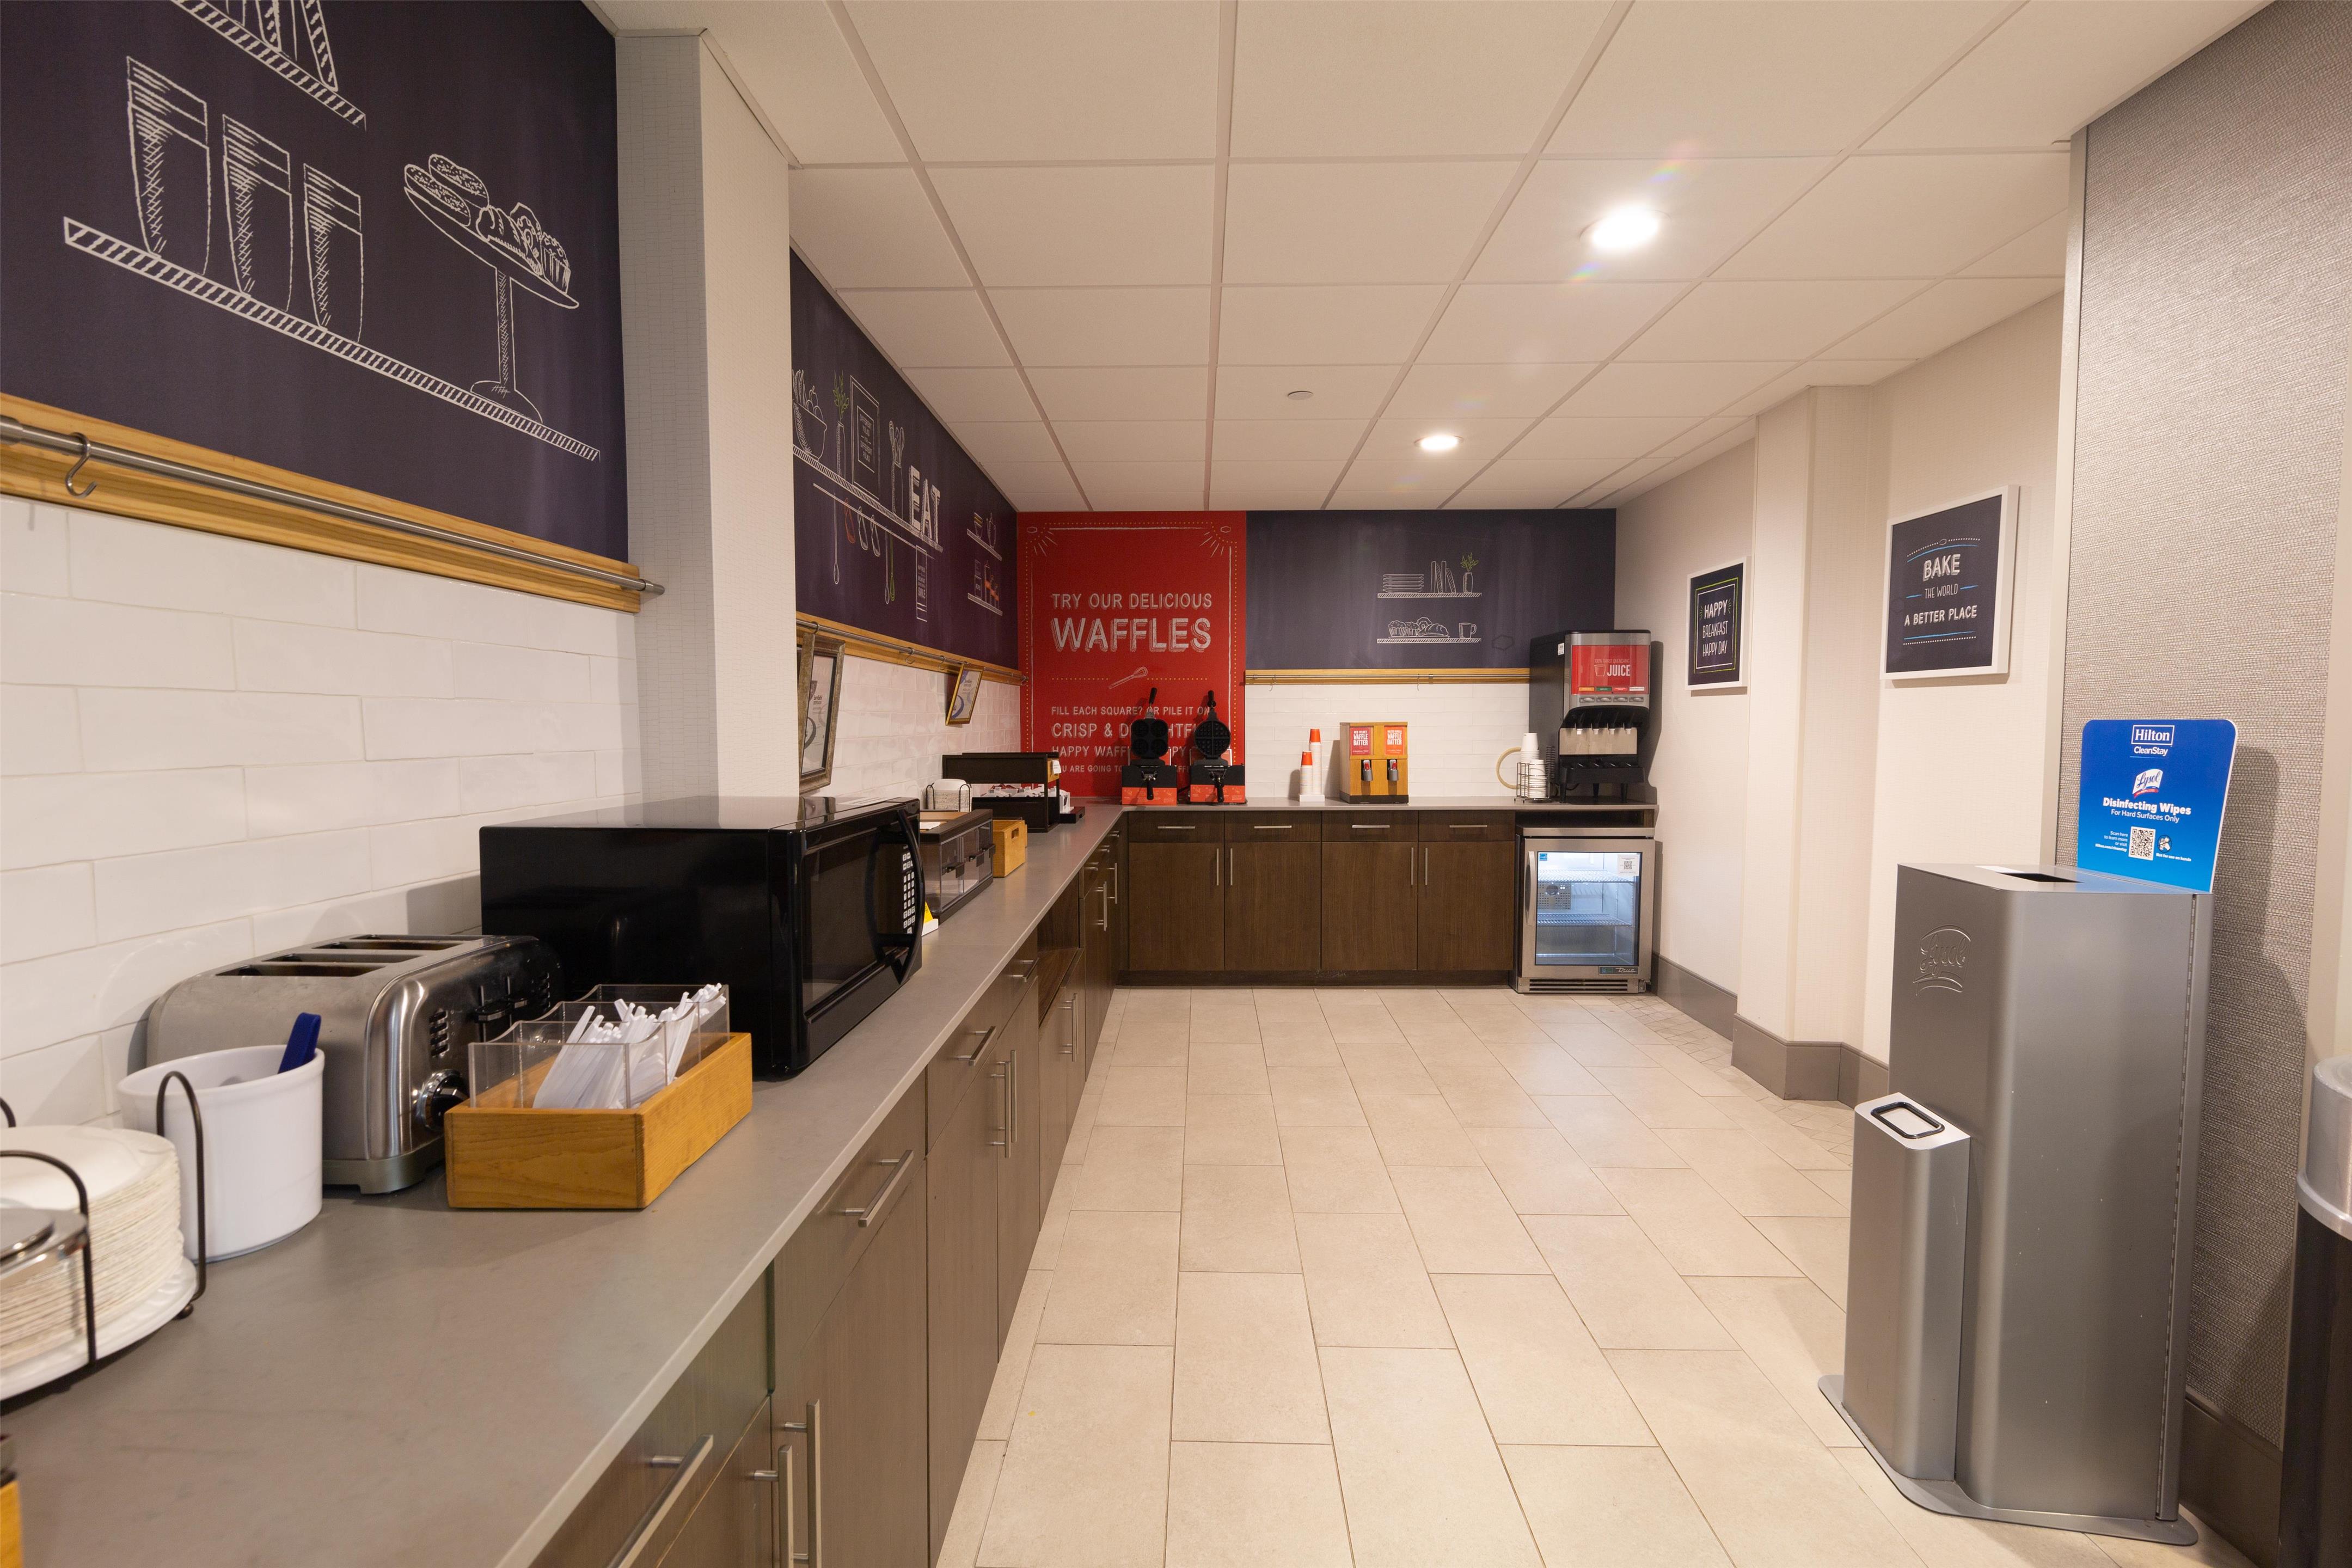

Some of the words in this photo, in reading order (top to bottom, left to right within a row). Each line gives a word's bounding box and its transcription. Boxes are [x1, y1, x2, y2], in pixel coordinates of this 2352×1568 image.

[909, 465, 941, 544] EAT
[1923, 554, 1961, 581] BAKE
[1925, 587, 1935, 599] THE
[1937, 583, 1958, 597] WORLD
[1051, 593, 1081, 609] TRY
[1089, 593, 1123, 609] OUR
[1129, 592, 1212, 609] DELICIOUS
[1704, 599, 1728, 620] HAPPY
[1904, 615, 1910, 627] A
[1913, 610, 1945, 625] BETTER
[1948, 605, 1977, 621] PLACE
[1050, 617, 1211, 653] WAFFLES
[1702, 621, 1729, 639] BREAKFAST
[1702, 641, 1718, 657] HAPPY
[1718, 640, 1728, 655] DAY
[1607, 664, 1631, 676] JUICE
[1051, 706, 1069, 715] FILL
[1073, 706, 1097, 715] EACH
[1100, 706, 1143, 715] SQUARE?
[1162, 706, 1183, 715] PILE
[1185, 706, 1194, 715] IT
[1052, 722, 1098, 738] CRISP
[1104, 722, 1113, 738] &
[2135, 728, 2170, 741] Hilton
[1094, 746, 1131, 758] WAFF
[2134, 746, 2169, 757] CleanStay
[2136, 770, 2161, 789] Lysol
[2103, 797, 2158, 813] Disinfecting
[2159, 803, 2191, 816] Wipes
[2136, 811, 2164, 820] Surfaces
[2164, 815, 2180, 824] Only
